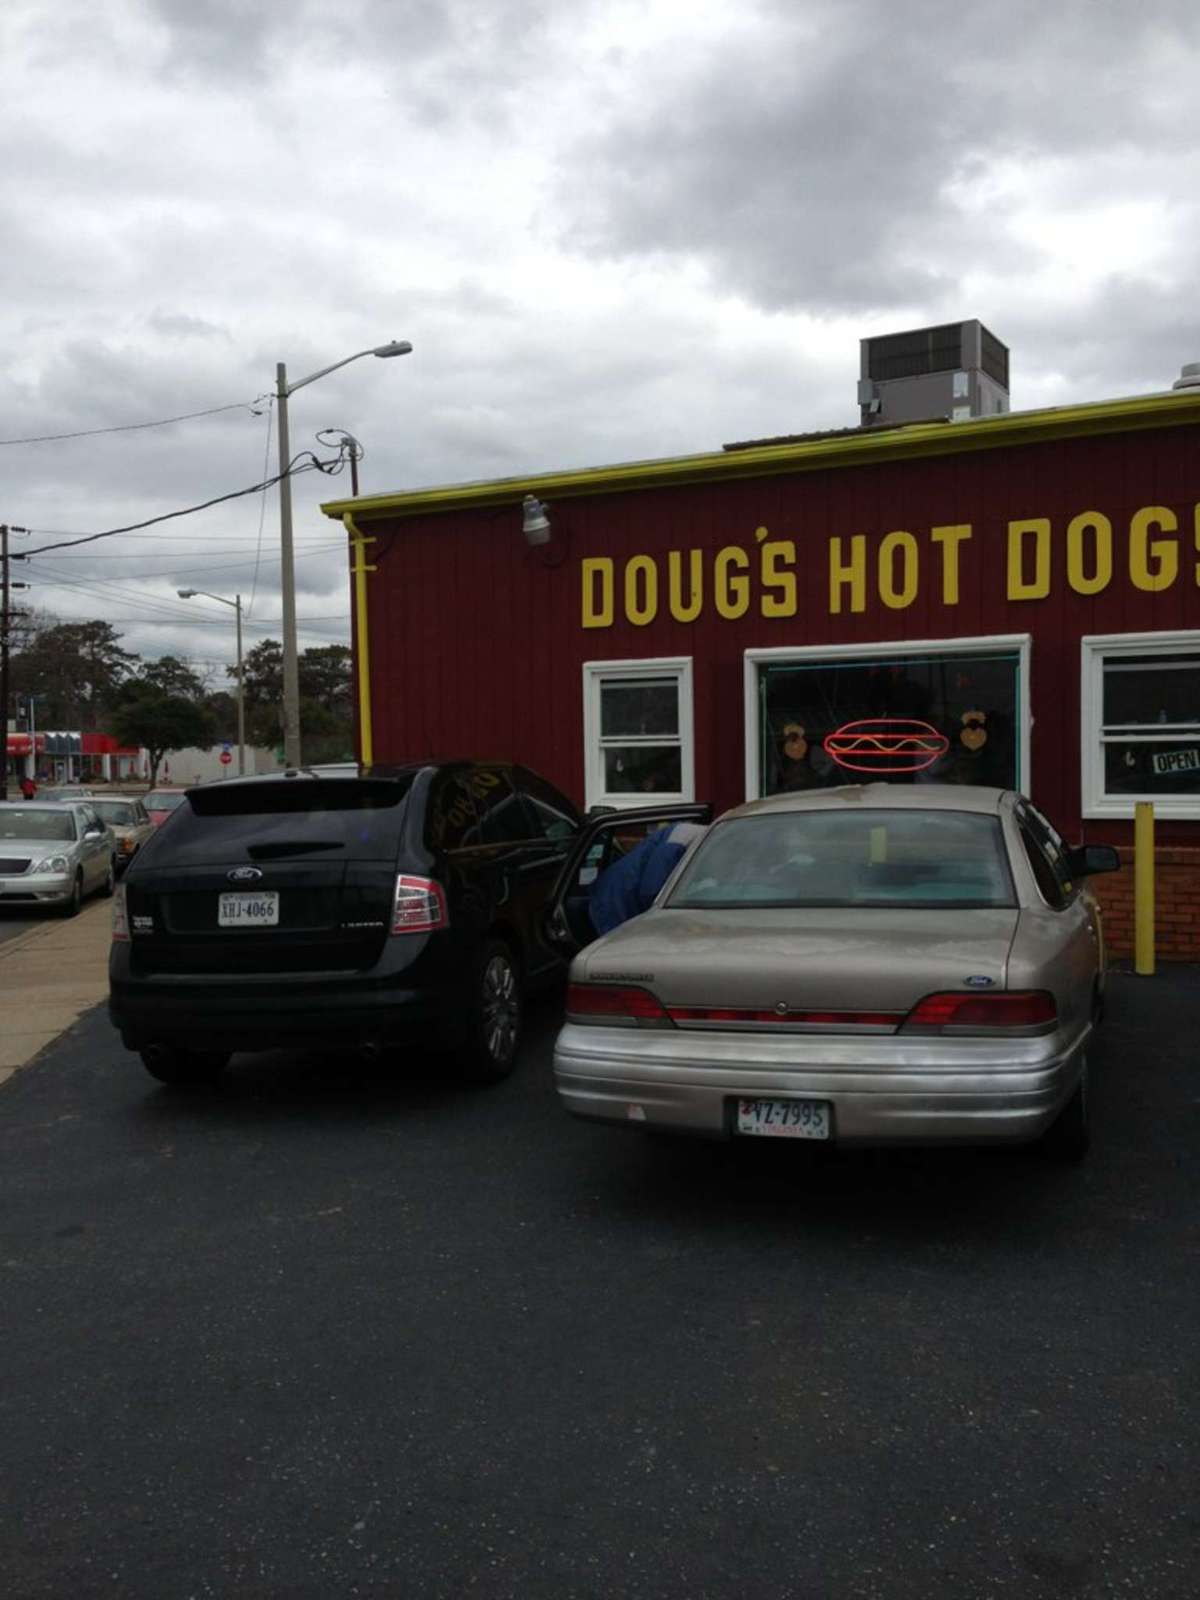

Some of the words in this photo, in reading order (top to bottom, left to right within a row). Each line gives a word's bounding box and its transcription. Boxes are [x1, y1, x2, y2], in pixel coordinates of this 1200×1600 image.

[581, 527, 798, 628] DOUG'S
[830, 524, 973, 614] HOT
[1007, 504, 1200, 601] DOG
[1156, 751, 1196, 772] OPEN
[222, 901, 274, 918] XHJ-4066
